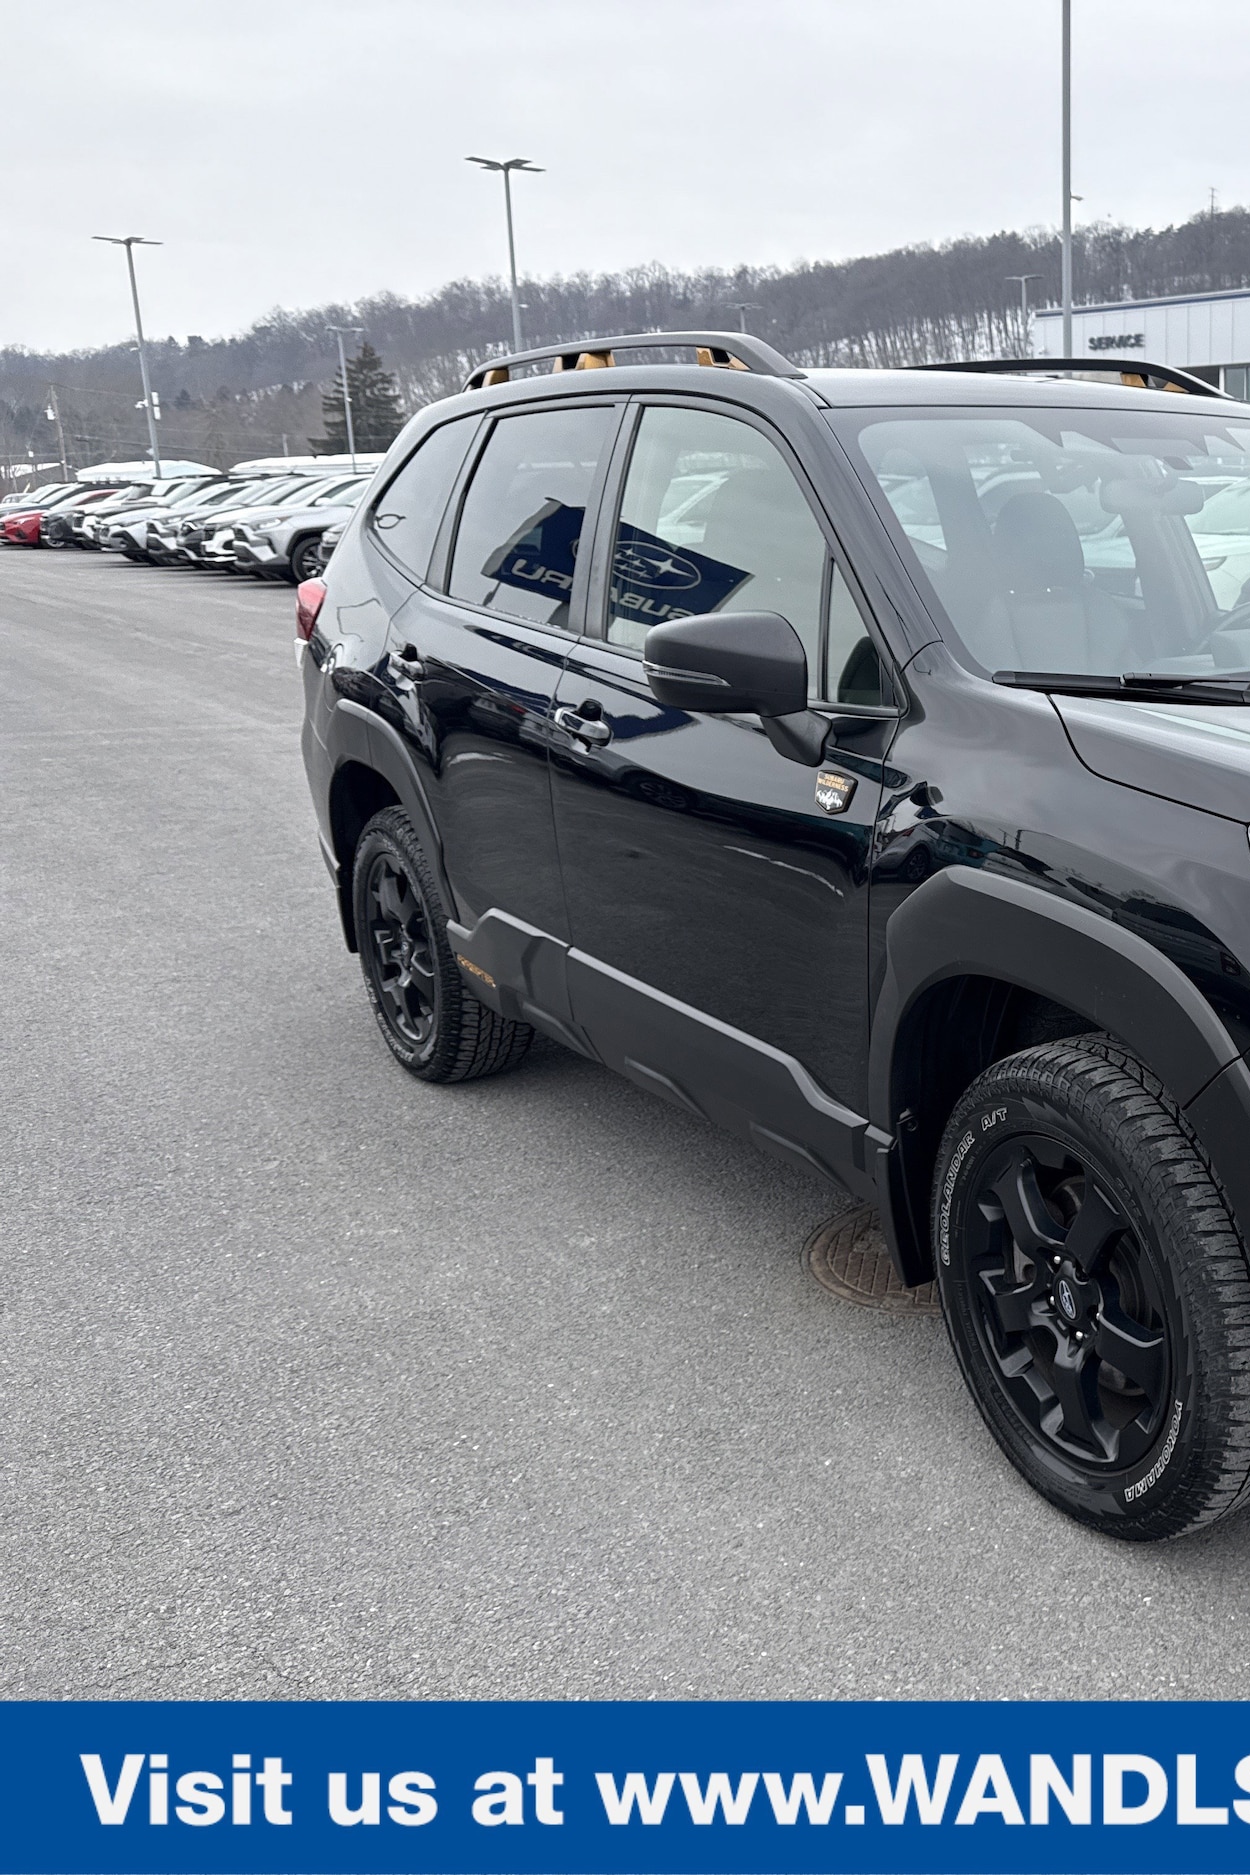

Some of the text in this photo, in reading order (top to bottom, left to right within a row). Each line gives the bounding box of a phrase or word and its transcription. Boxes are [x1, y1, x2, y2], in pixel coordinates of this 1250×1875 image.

[1087, 333, 1145, 351] SERVICE
[939, 1131, 976, 1266] GEOLANDAR
[981, 1107, 1007, 1131] A/T
[1124, 1399, 1183, 1502] YOKOHAMA
